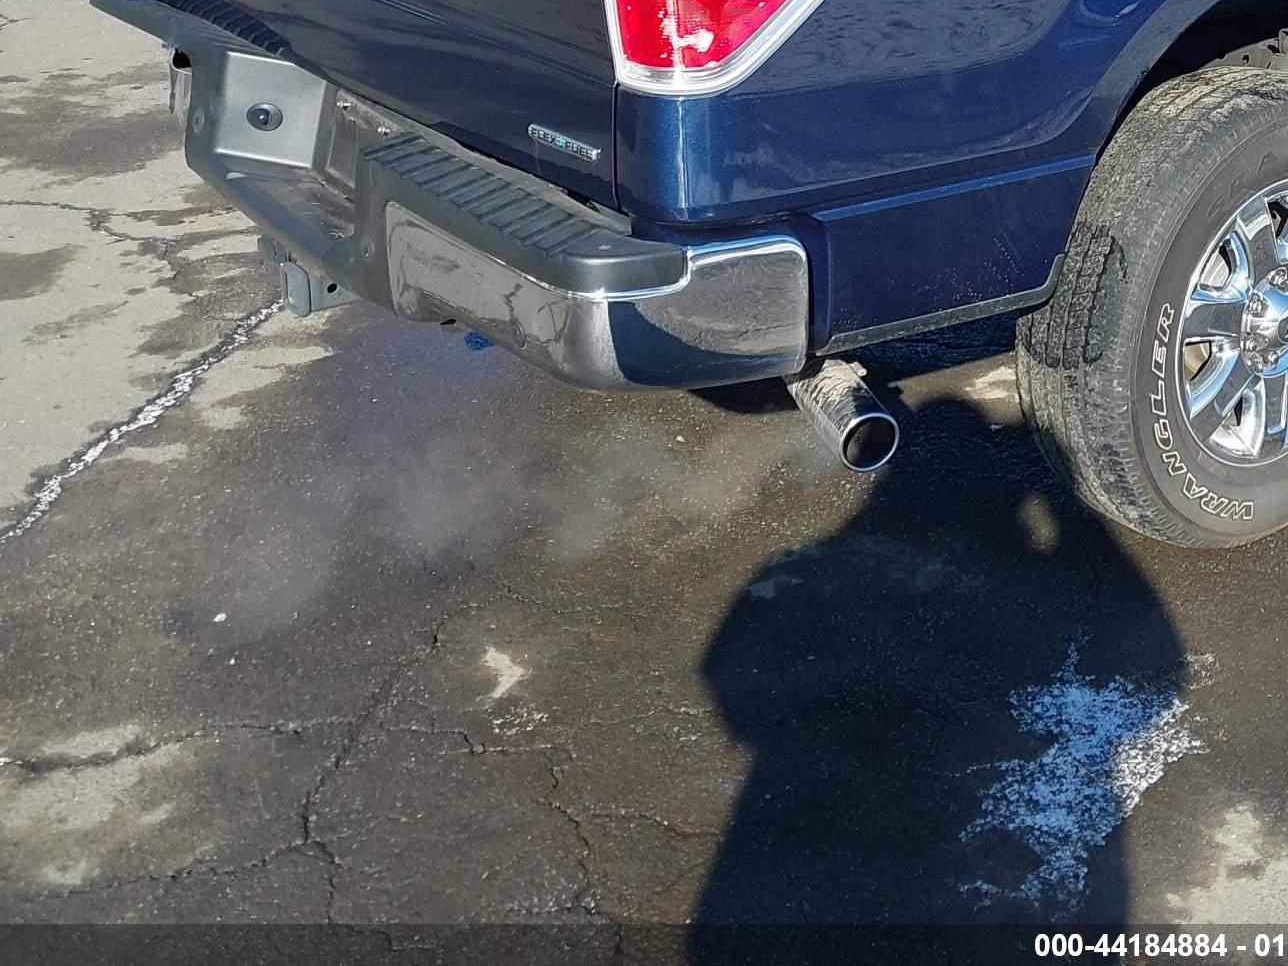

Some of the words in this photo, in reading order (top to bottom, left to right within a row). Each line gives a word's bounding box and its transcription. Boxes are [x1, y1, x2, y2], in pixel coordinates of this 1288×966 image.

[529, 126, 555, 144] FLEX
[564, 141, 595, 161] FUEL
[1149, 302, 1255, 520] WRANGLER
